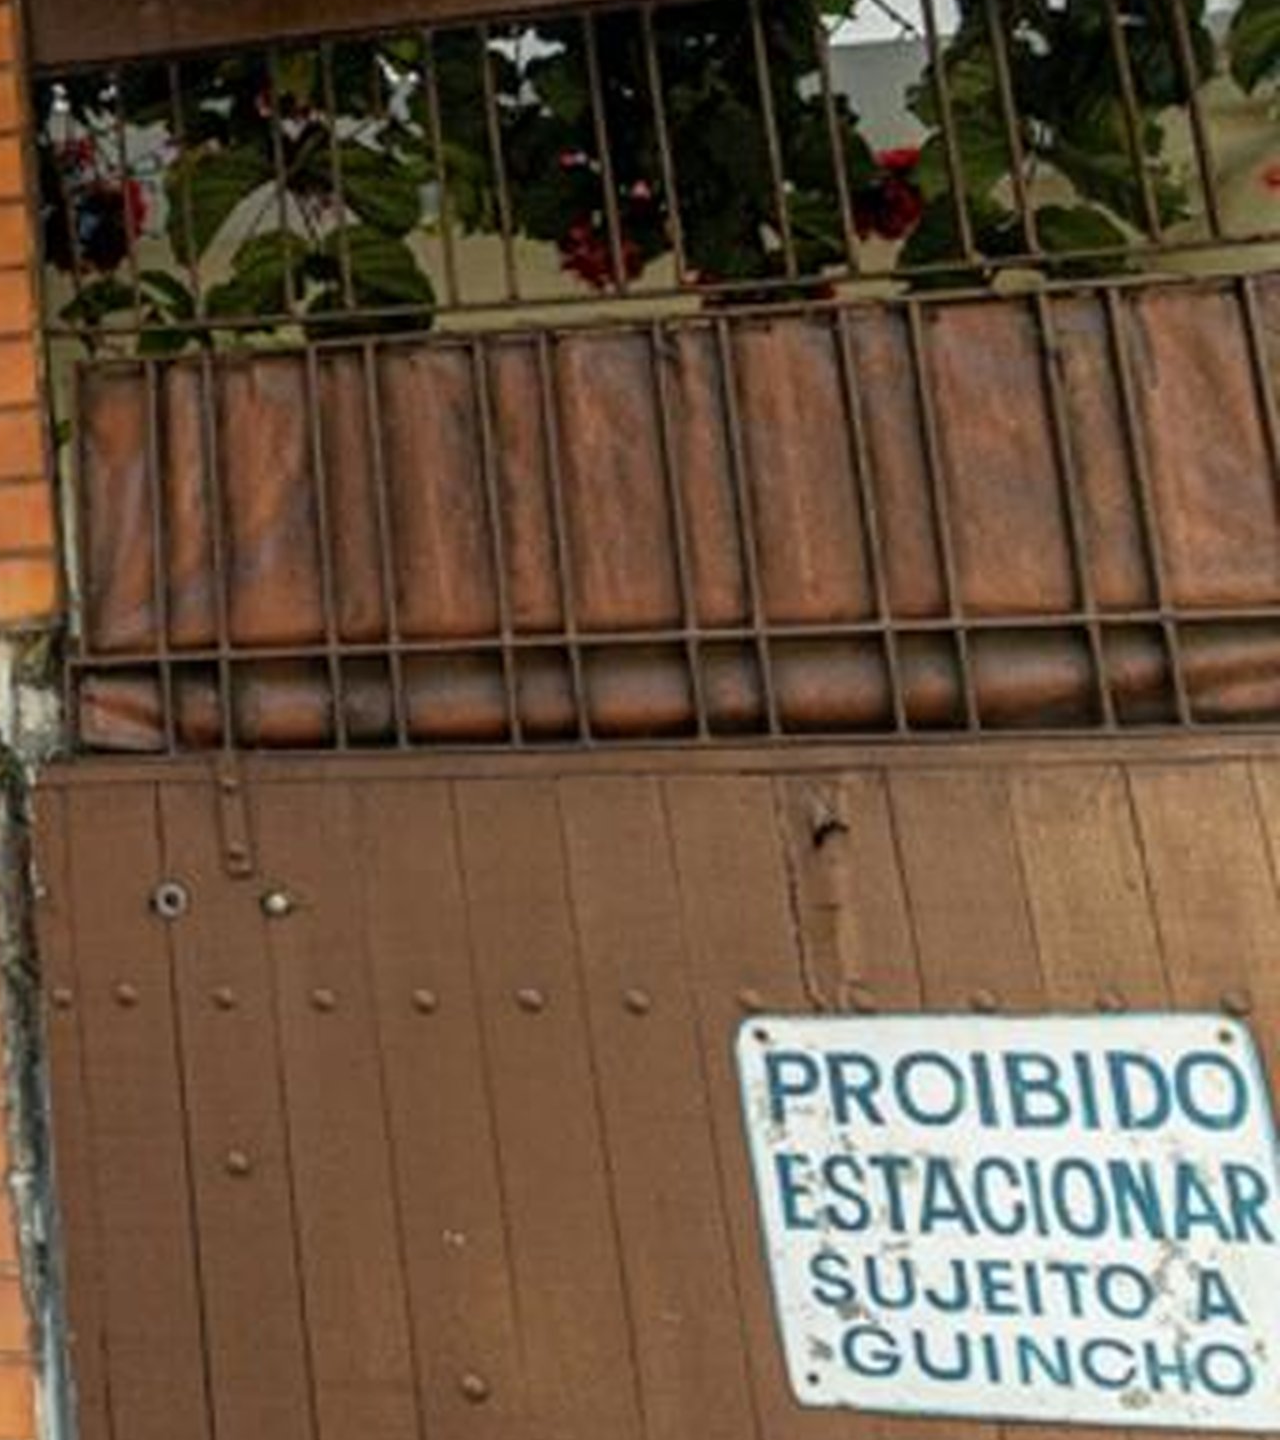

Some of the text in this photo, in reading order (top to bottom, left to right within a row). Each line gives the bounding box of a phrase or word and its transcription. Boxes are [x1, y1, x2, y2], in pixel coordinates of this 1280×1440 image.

[763, 1050, 1250, 1131] PROIBIDO
[773, 1152, 1277, 1244] ESTACIONAR
[808, 1251, 1247, 1325] SUJEITO A
[840, 1324, 1256, 1398] GUINCHO
